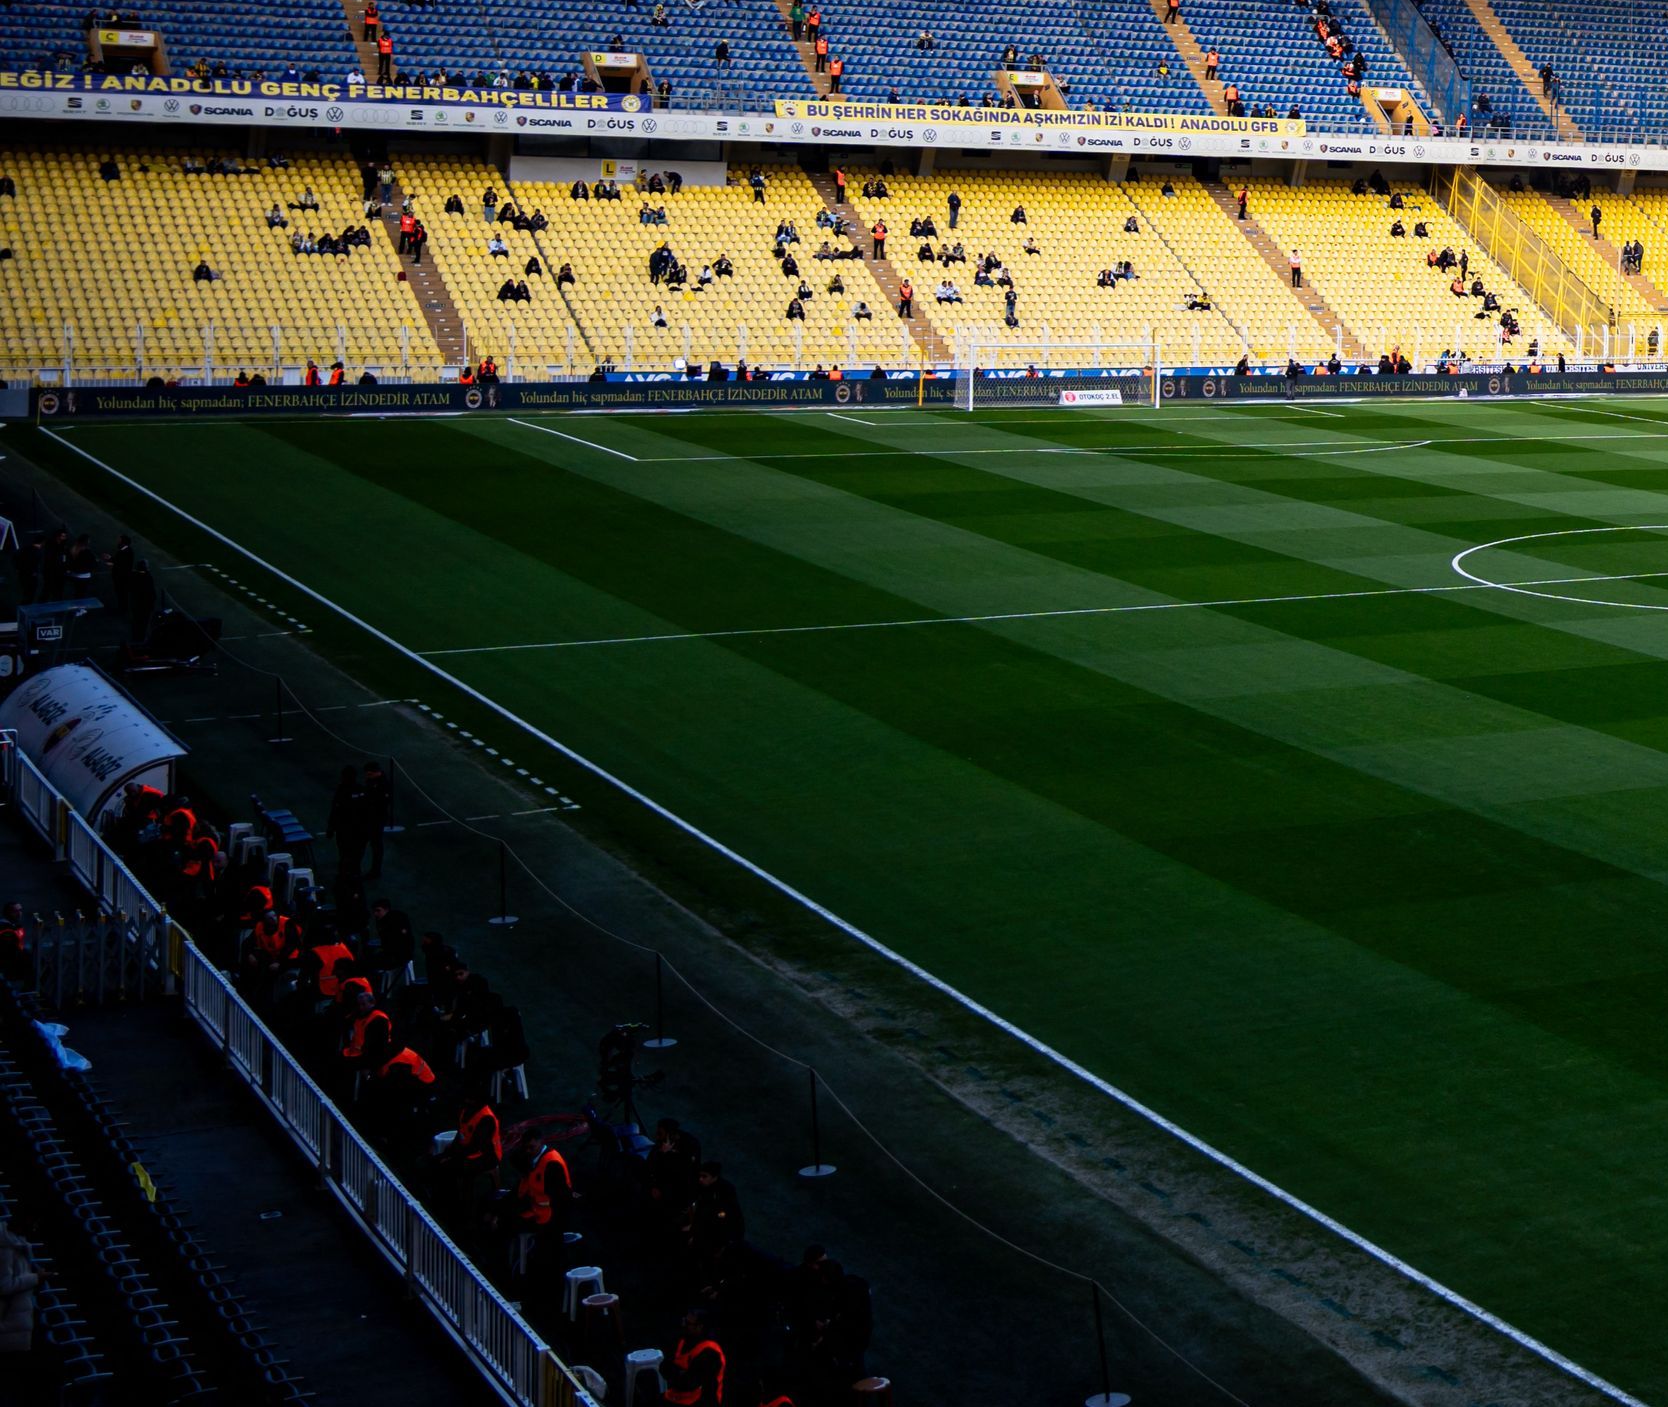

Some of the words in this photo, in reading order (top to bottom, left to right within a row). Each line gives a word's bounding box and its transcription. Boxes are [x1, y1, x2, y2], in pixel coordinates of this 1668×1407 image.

[106, 33, 114, 41] C
[595, 54, 602, 62] D
[101, 76, 250, 95] ANADOLU
[260, 82, 341, 101] GENÇ
[349, 85, 609, 109] FENERBAHÇELİLER
[204, 106, 254, 116] SCANIA
[529, 118, 572, 128] SCANIA
[807, 104, 828, 117] BU
[833, 104, 892, 121] ŞEHRİN
[895, 107, 926, 120] HER
[930, 107, 1020, 124] SOKAĞINDA
[1024, 111, 1101, 128] AŞKIMIZIN
[1104, 113, 1122, 126] İZİ
[1126, 115, 1167, 128] KALDI
[1180, 118, 1248, 132] ANADOLU
[1251, 120, 1278, 133] GFB
[822, 129, 862, 138] SCANIA
[1087, 138, 1123, 147] SCANIA
[1329, 146, 1362, 155] SCANIA
[1552, 154, 1582, 162] SCANIA
[606, 161, 614, 174] L
[520, 392, 569, 403] Yolundan
[572, 391, 588, 405] hiç
[591, 392, 645, 405] sapmadan;
[648, 389, 725, 403] FENERBAHÇE
[728, 387, 788, 401] İZİNDEDİR
[792, 388, 823, 399] ATAM
[1079, 393, 1104, 402] OTOKOÇ
[97, 396, 155, 408] Yolundan
[159, 395, 178, 411] hiç
[181, 397, 244, 411] sapmadan;
[248, 393, 337, 410] FENERBAHÇE
[340, 392, 409, 406] İZİNDEDİR
[413, 393, 449, 404] ATAM
[40, 628, 60, 637] VAR
